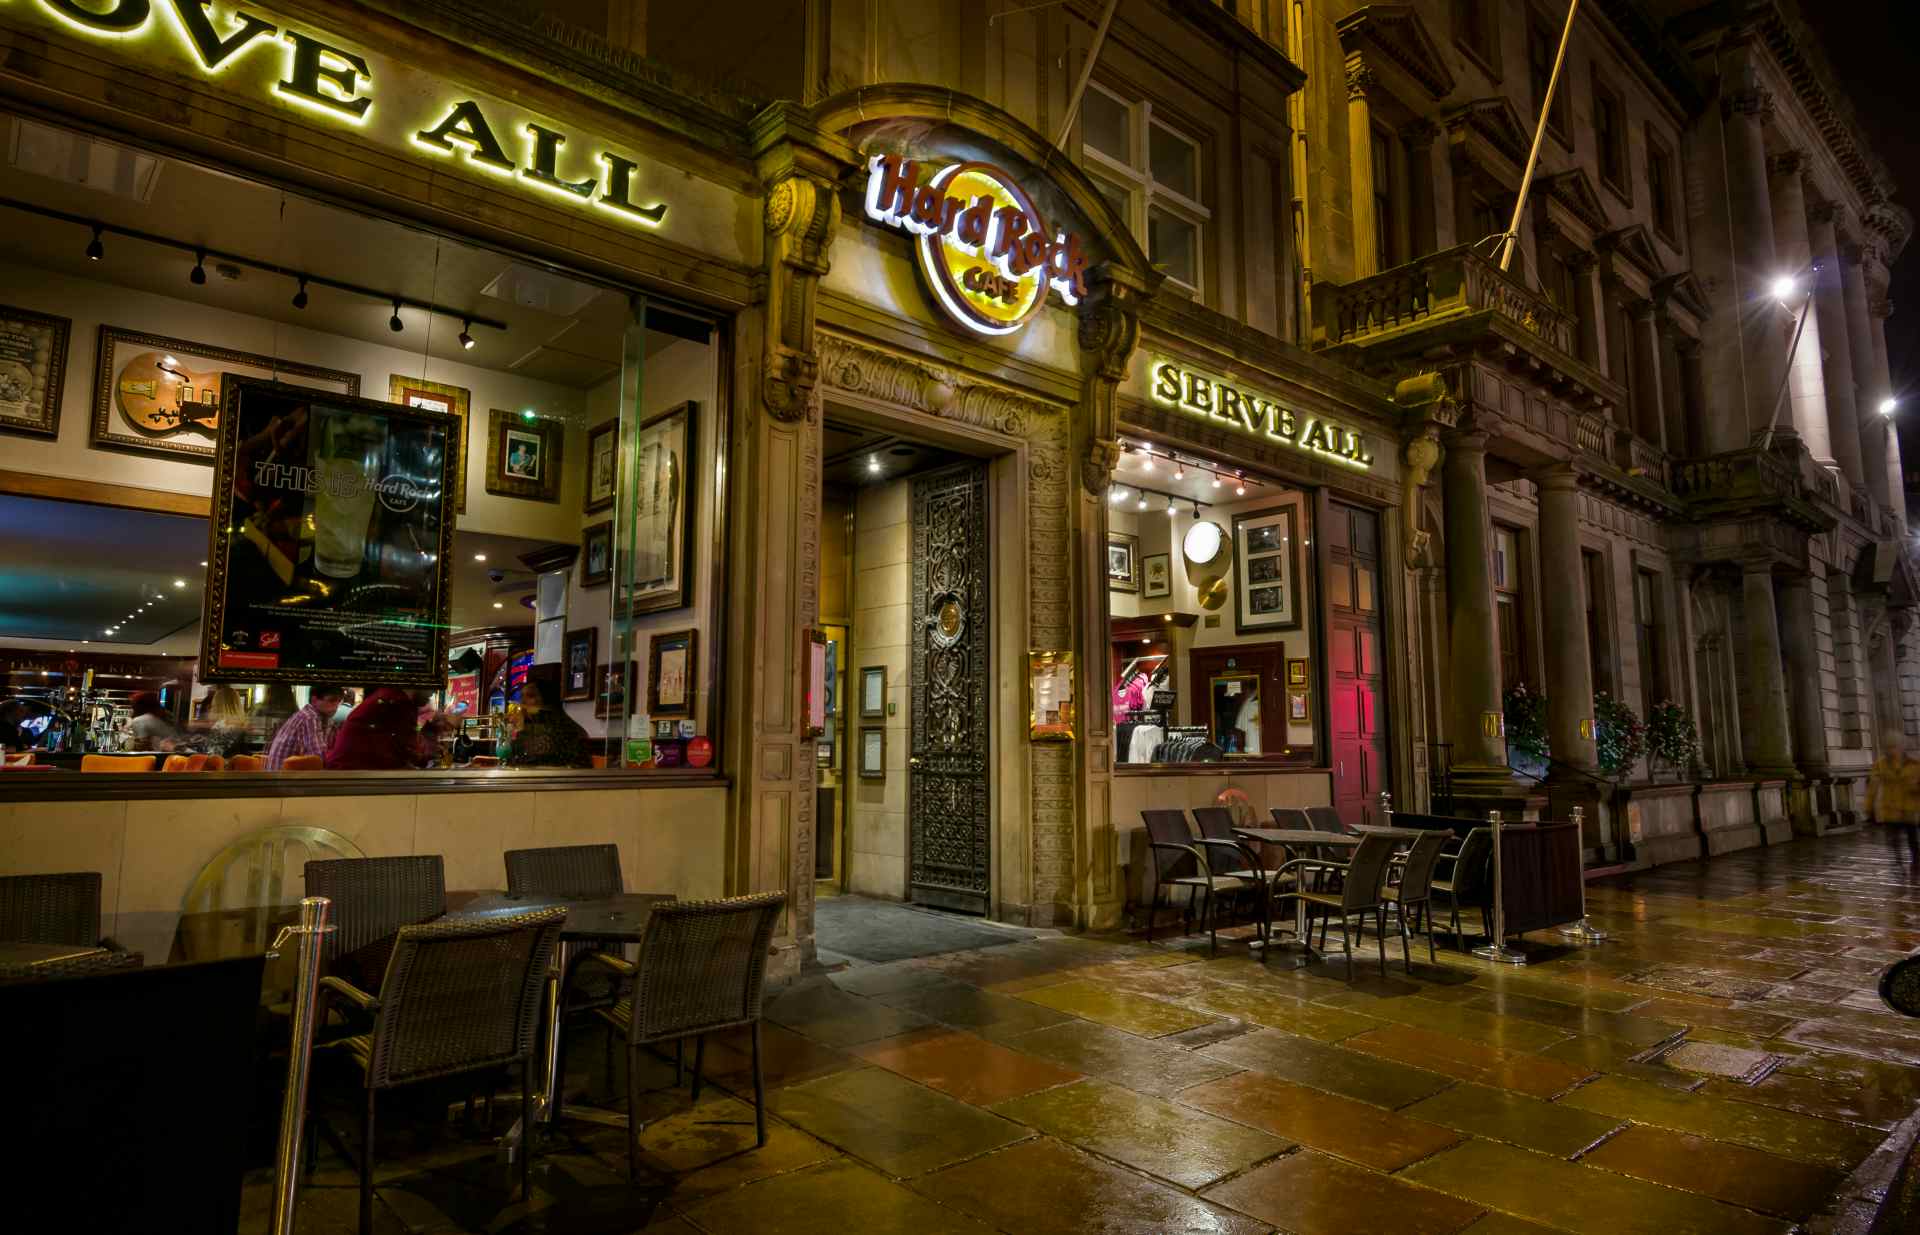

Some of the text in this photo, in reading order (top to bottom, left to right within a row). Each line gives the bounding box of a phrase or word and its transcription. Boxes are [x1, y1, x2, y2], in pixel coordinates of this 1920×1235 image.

[416, 100, 668, 224] ALL
[866, 154, 1089, 300] Hard Rock
[962, 266, 1019, 304] CAFE
[1155, 363, 1374, 467] SERVE ALL
[255, 461, 324, 493] THIS
[364, 477, 433, 499] Hard Rock
